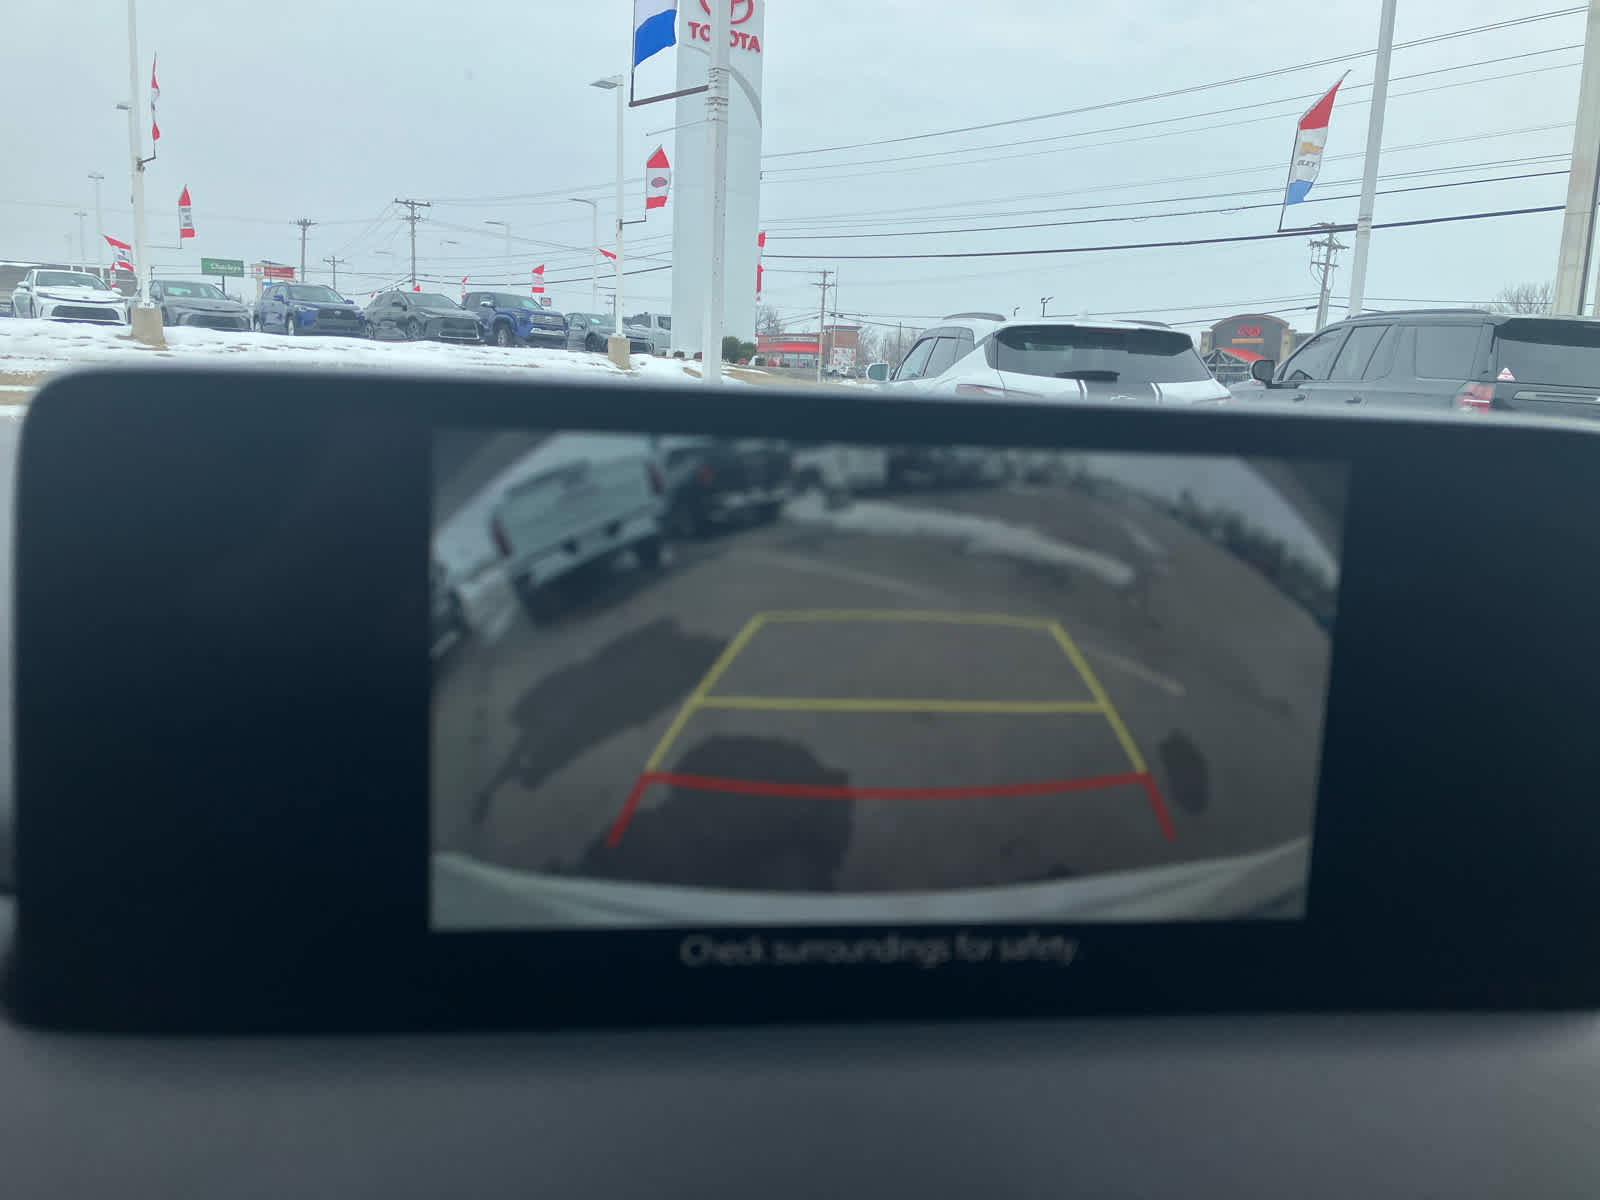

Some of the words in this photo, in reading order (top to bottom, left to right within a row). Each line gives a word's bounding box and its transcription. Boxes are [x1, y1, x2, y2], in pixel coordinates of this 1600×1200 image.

[687, 20, 761, 53] TOOTA
[680, 934, 763, 967] Check
[774, 933, 951, 968] surroundings
[954, 931, 993, 963] for
